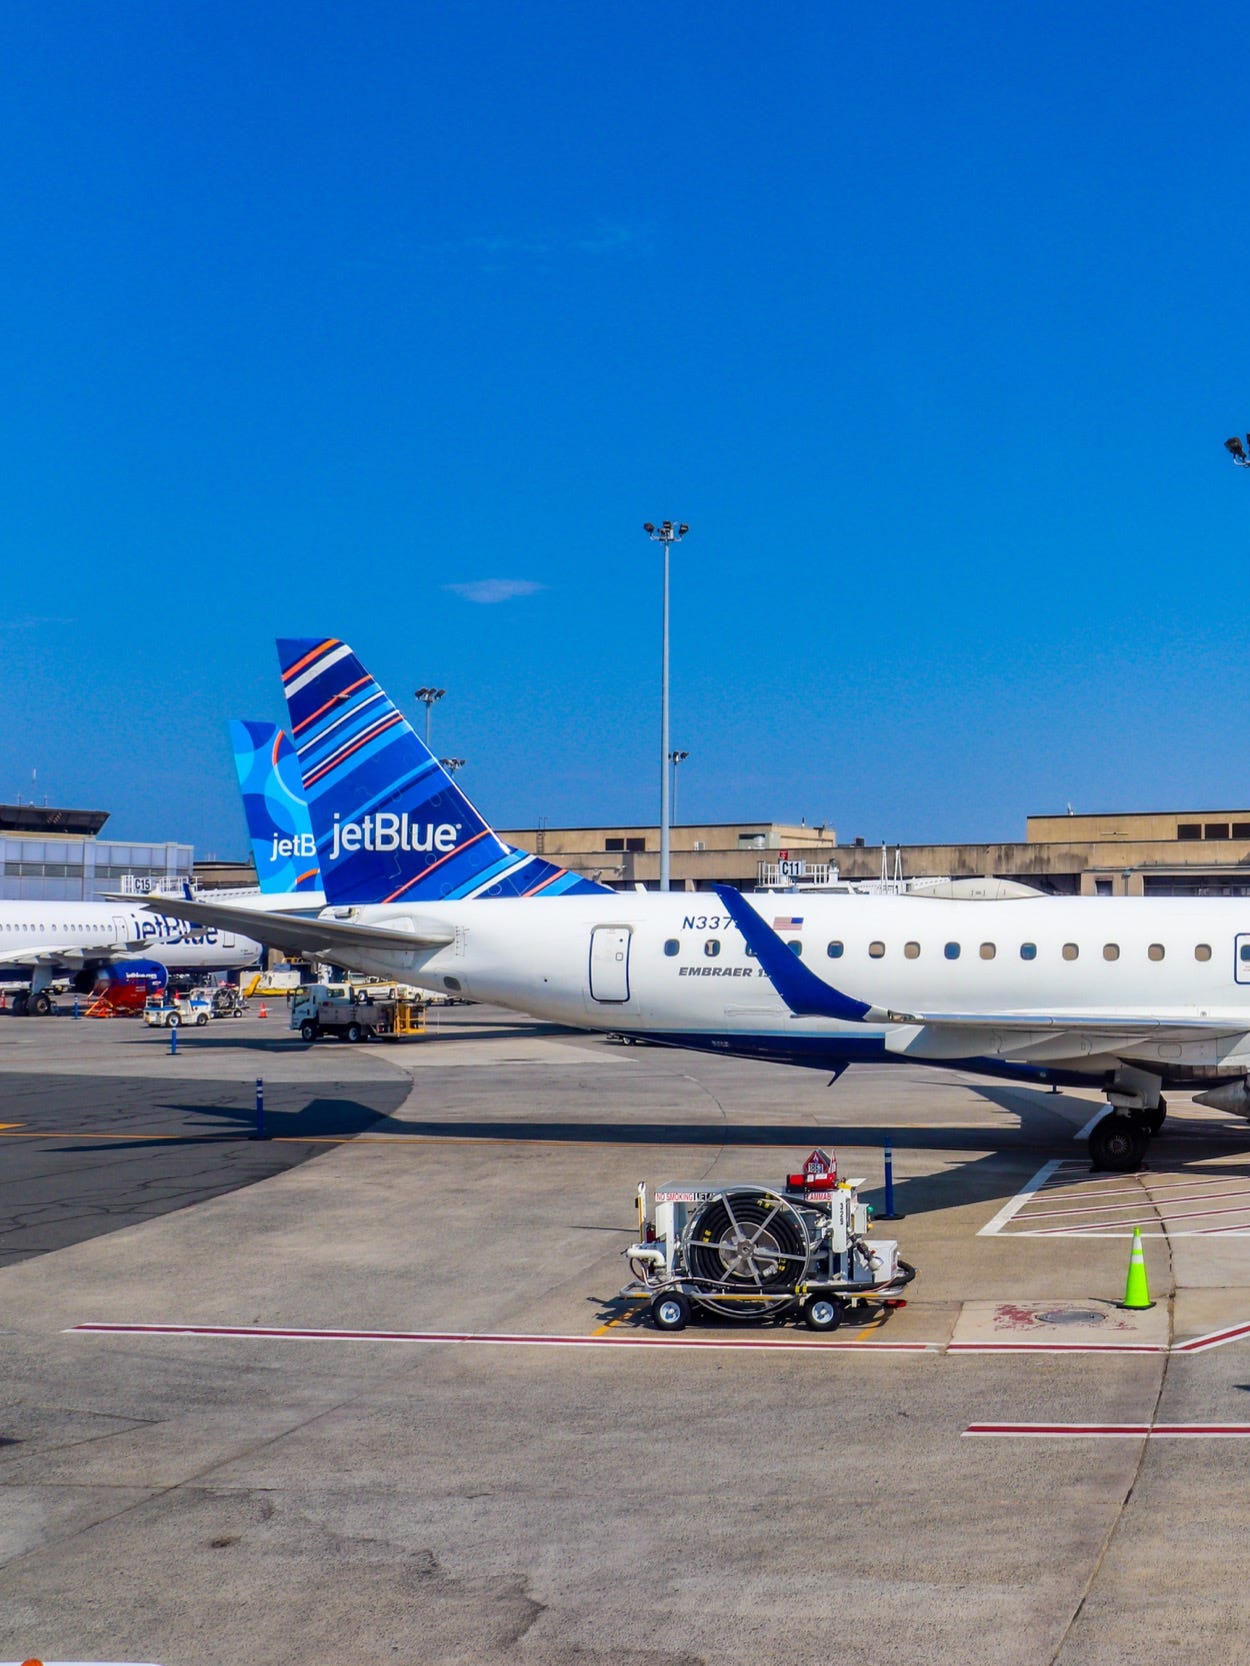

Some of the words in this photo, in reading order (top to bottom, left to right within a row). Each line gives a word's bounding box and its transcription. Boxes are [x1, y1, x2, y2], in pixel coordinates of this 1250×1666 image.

[330, 813, 459, 860] jetBlue
[270, 833, 316, 862] jetB
[782, 861, 799, 875] C11
[135, 879, 151, 890] C15
[682, 915, 738, 930] N337
[679, 967, 753, 977] EMBRAER
[666, 1192, 694, 1201] SMOKING
